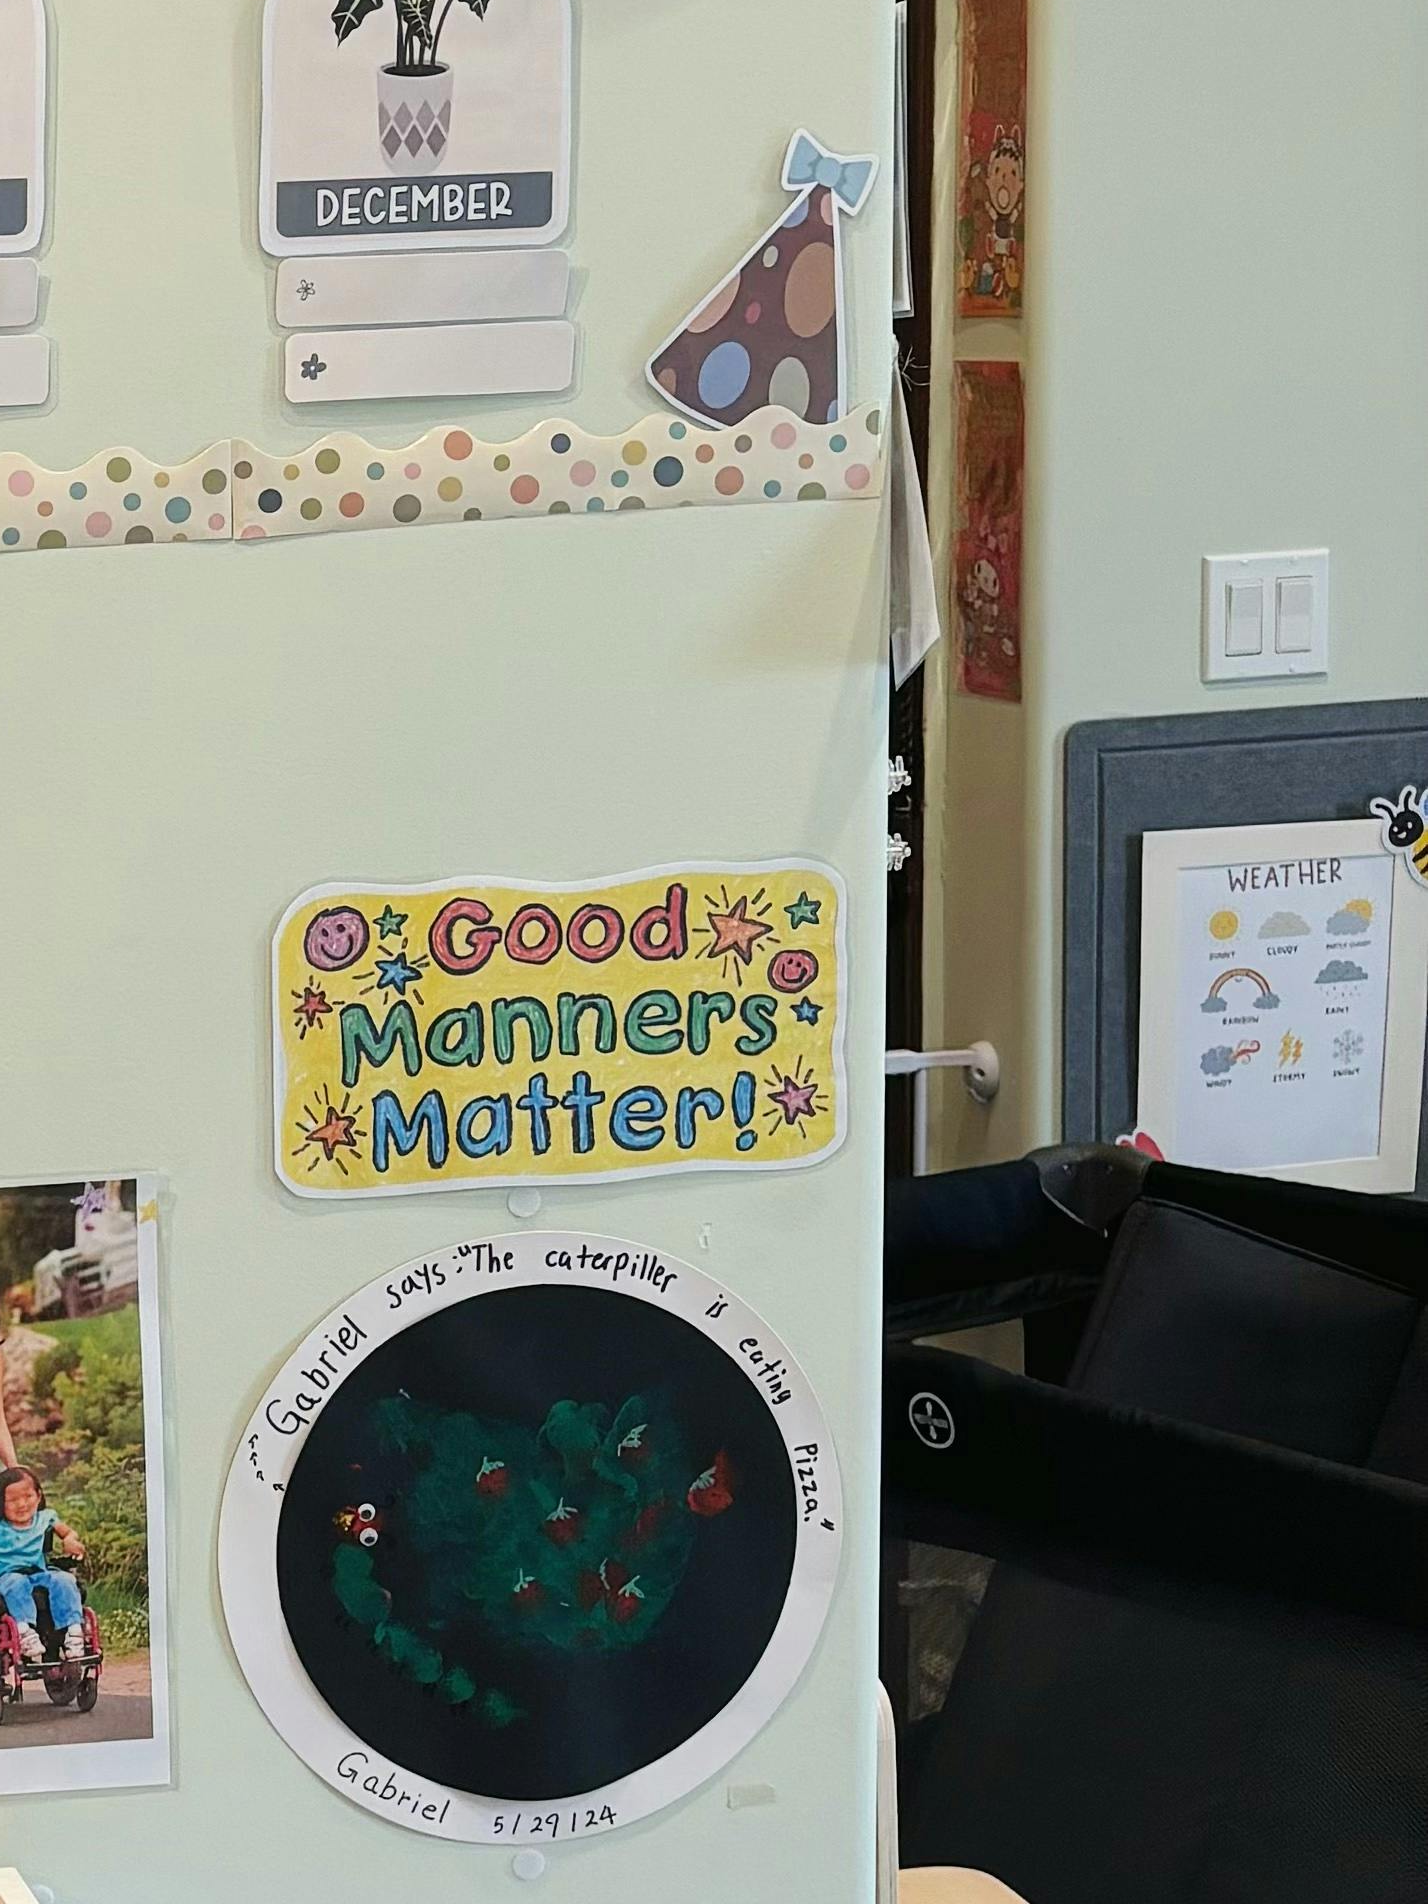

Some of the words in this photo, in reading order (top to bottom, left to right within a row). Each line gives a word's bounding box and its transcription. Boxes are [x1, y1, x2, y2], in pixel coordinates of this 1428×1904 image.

[316, 181, 513, 226] DECEMBER
[1228, 857, 1343, 893] WEATHER
[429, 883, 688, 972] Good
[341, 983, 779, 1090] Manners
[372, 1070, 757, 1174] Matter!
[266, 1314, 367, 1435] Gabriel
[545, 1244, 678, 1292] caterpiller
[705, 1294, 729, 1318] is
[739, 1337, 792, 1406] eating
[337, 1752, 451, 1825] Gabriel
